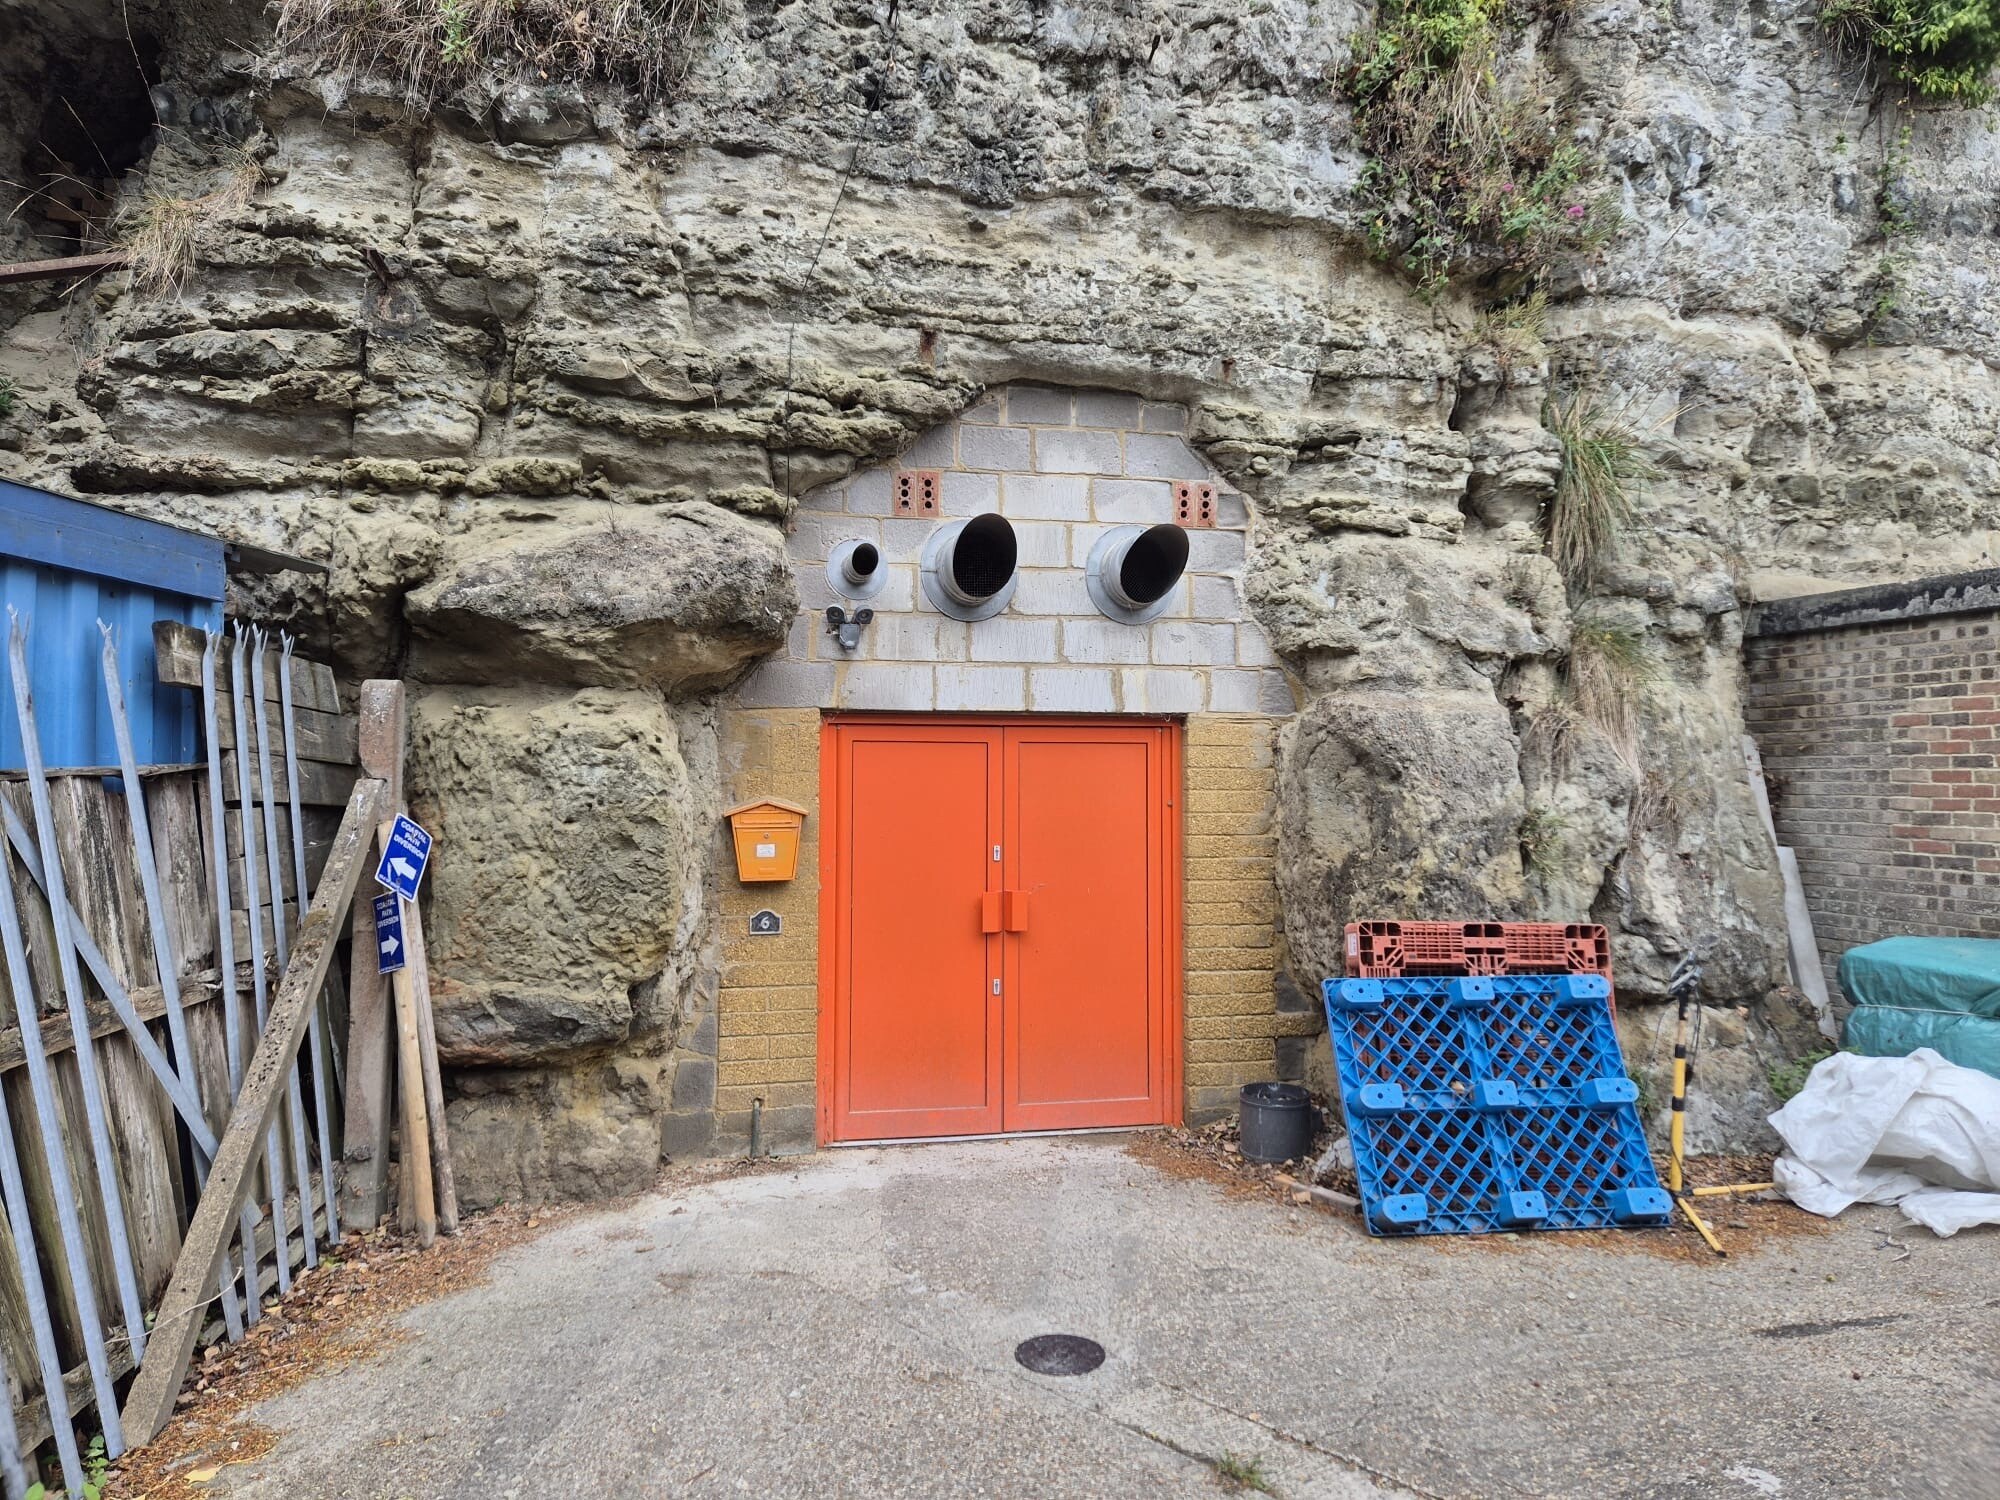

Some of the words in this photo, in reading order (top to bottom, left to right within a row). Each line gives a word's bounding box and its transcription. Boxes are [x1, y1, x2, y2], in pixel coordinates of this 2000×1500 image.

[401, 821, 427, 844] COASTAL
[405, 832, 421, 847] PATH
[394, 834, 425, 860] DIVERSION
[381, 908, 393, 918] PATH
[377, 915, 399, 928] DIVERSION
[760, 916, 770, 929] 6
